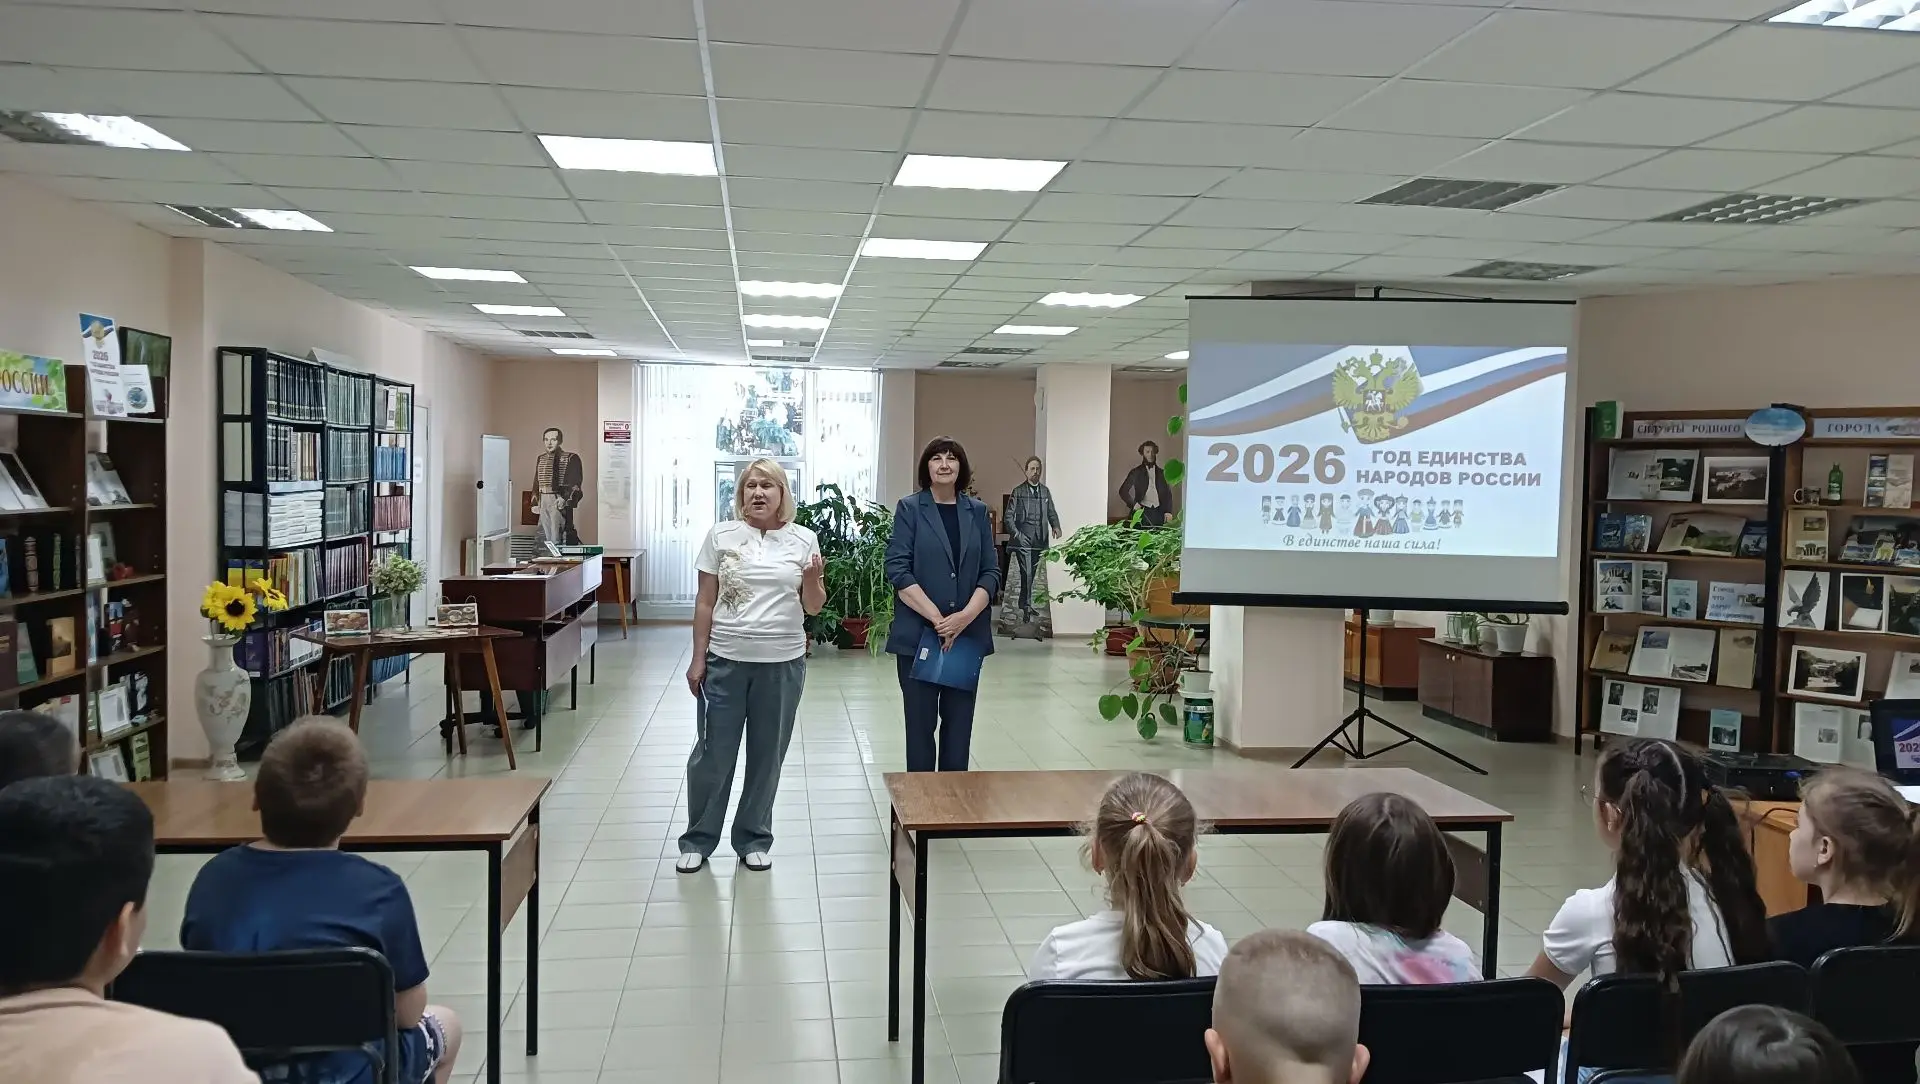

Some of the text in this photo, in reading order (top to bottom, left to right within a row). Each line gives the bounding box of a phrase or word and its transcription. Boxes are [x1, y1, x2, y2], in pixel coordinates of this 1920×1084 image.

[0, 369, 50, 395] ОССИИ
[1692, 424, 1741, 434] РОДНОГО
[1827, 423, 1880, 434] ГОРОДА
[1205, 442, 1346, 485] 2026
[1371, 450, 1528, 467] ГОД ЕДИНСТВА
[1356, 469, 1542, 487] НАРОДОВ РОССИИ
[1283, 533, 1441, 550] В единстве наша сила!
[1899, 742, 1920, 753] 202
